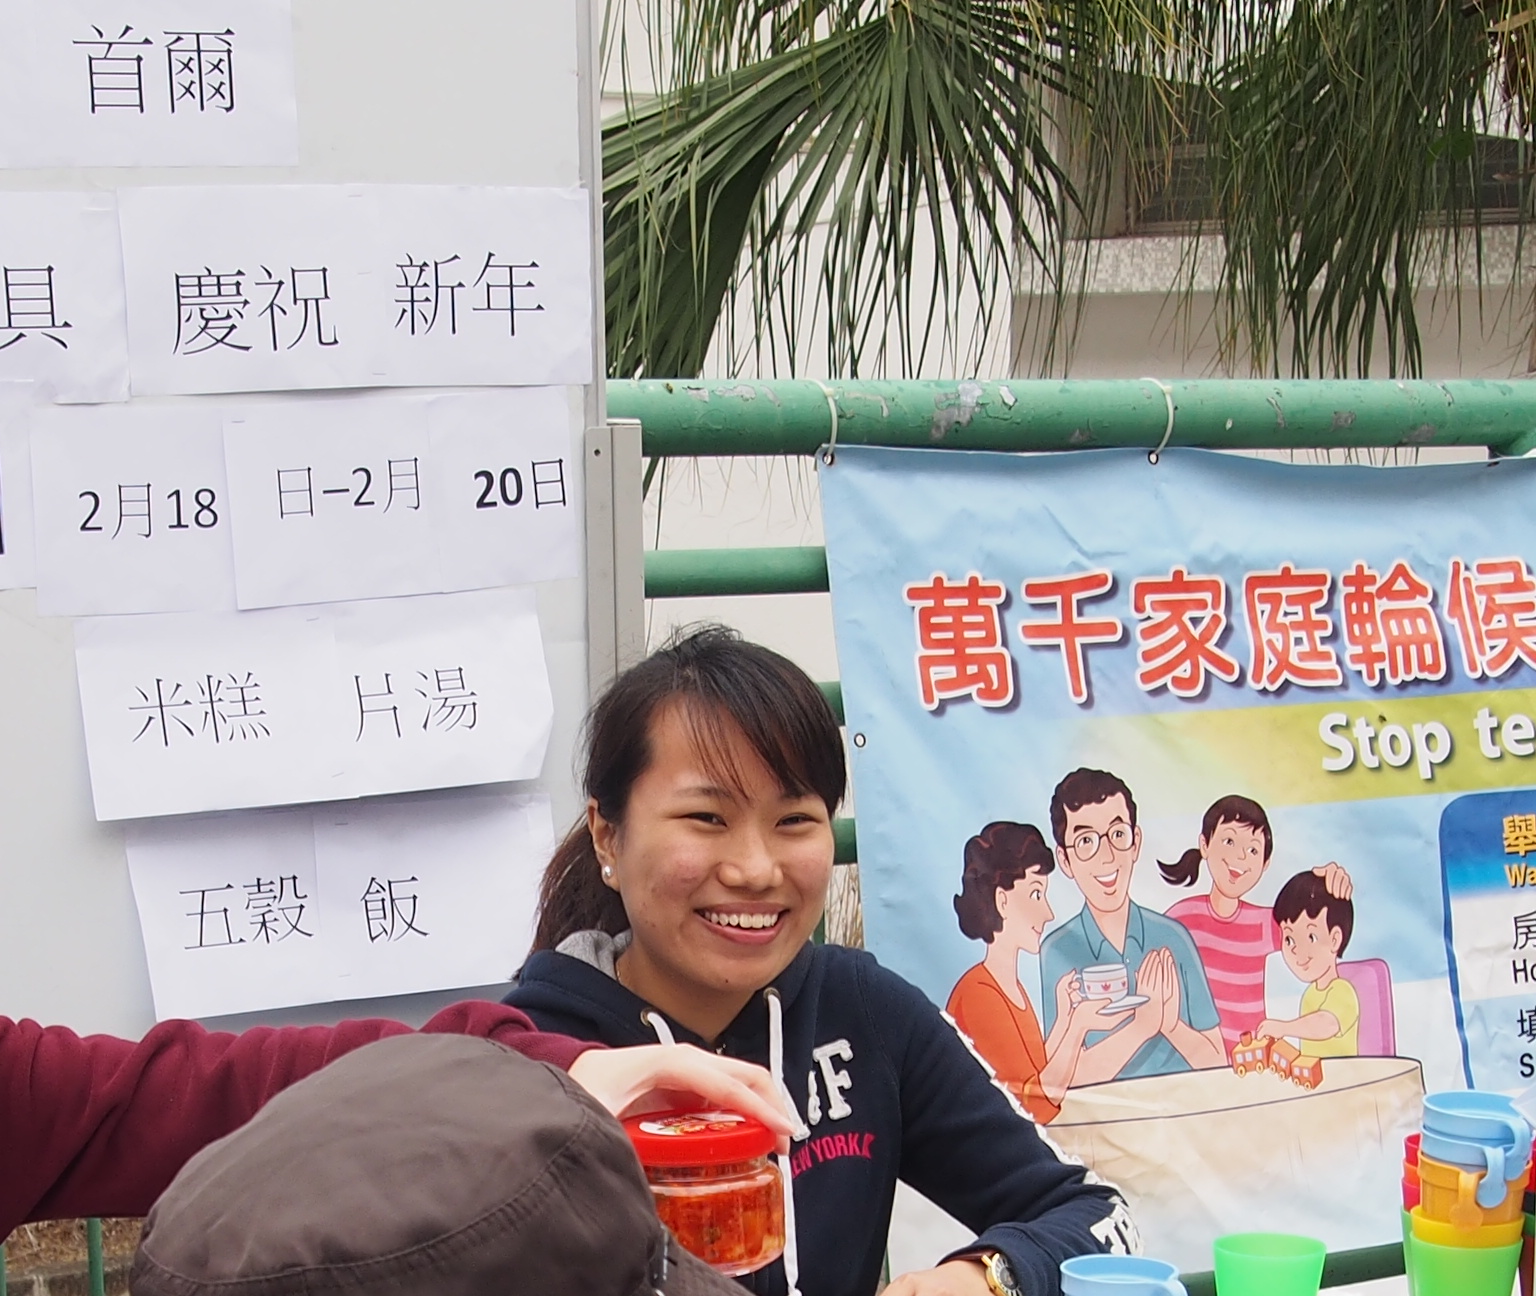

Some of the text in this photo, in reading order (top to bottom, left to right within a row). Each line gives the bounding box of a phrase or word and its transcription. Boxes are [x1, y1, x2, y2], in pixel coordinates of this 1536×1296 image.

[72, 24, 236, 115] 首爾
[172, 251, 546, 356] 慶祝 新年
[78, 482, 219, 540] 2月18
[473, 457, 567, 510] 20日
[128, 666, 477, 748] 米糕 片湯
[1318, 711, 1453, 780] Stop
[179, 874, 430, 950] 五穀 飯
[810, 1131, 860, 1164] YORK
